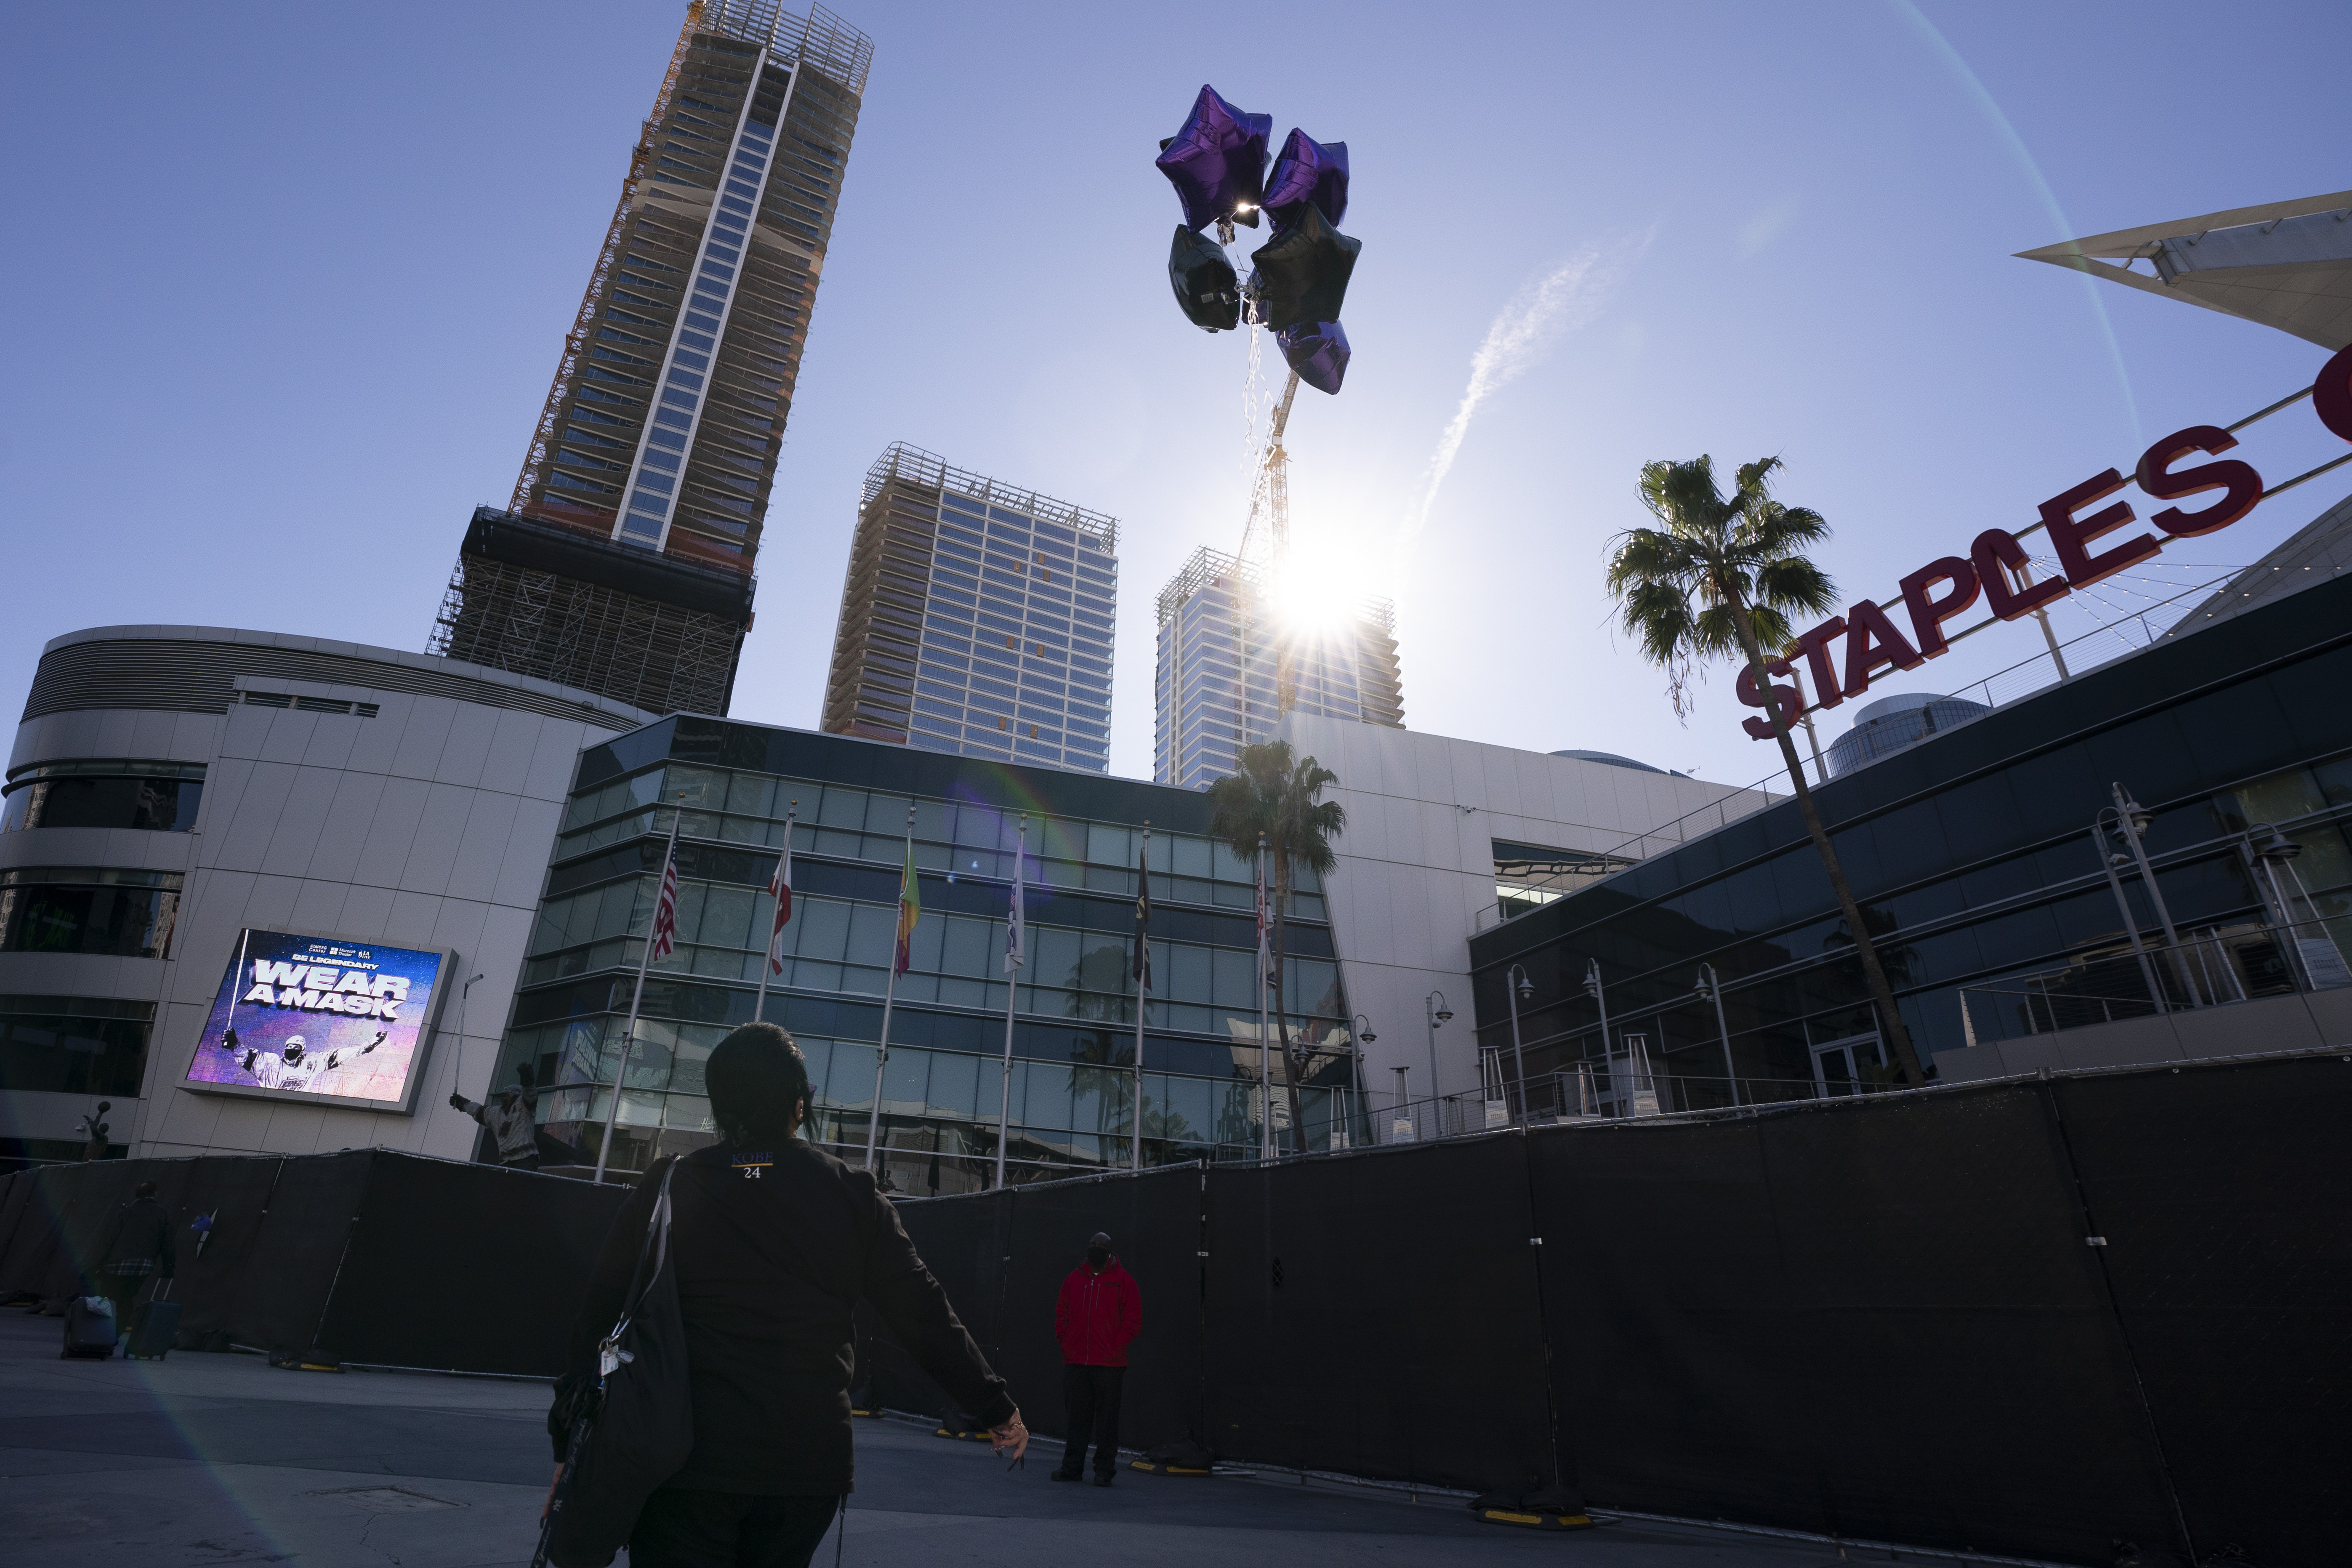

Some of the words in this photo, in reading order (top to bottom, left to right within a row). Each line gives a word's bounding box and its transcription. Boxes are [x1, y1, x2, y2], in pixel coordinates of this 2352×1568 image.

[1736, 425, 2263, 739] STAPLES
[309, 956, 380, 970] LEGENDARY
[255, 958, 411, 1000] WEAR
[243, 983, 276, 1004] A
[281, 987, 399, 1019] MASK
[732, 1151, 774, 1165] KOBE
[743, 1167, 761, 1178] 24
